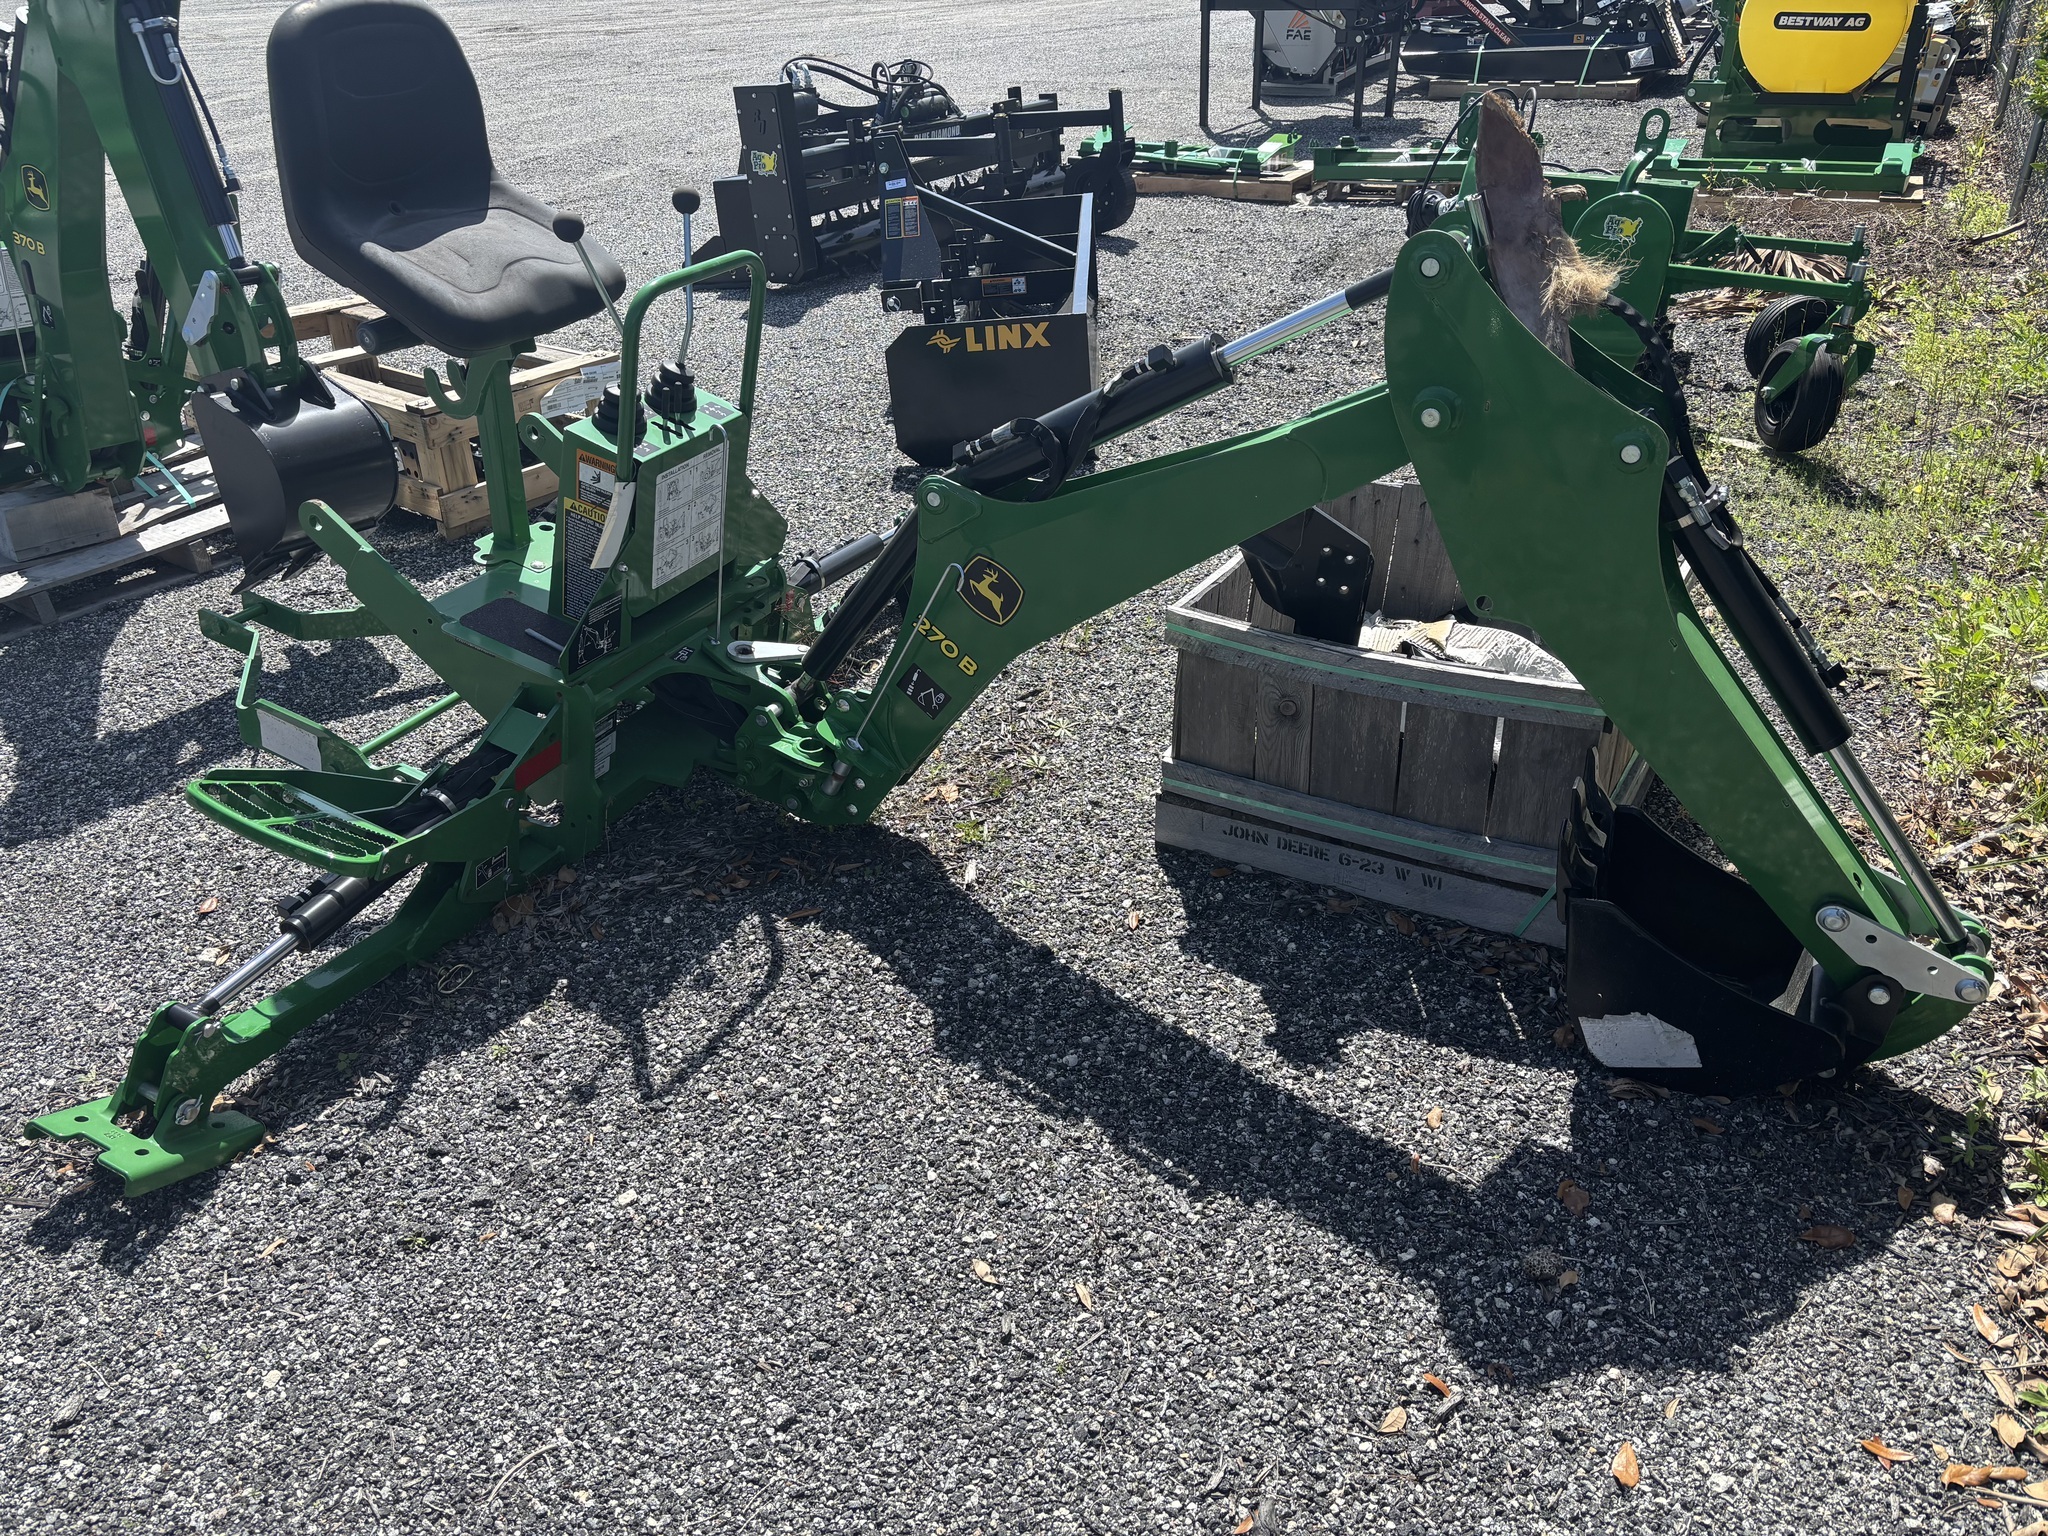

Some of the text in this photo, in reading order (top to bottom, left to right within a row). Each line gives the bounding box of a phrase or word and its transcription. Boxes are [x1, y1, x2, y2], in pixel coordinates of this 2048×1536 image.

[1460, 0, 1511, 45] ANGER STAND CLEAR
[1778, 16, 1866, 27] BESTWAY AG
[1286, 29, 1312, 40] FAE
[931, 125, 960, 139] DIAMOND
[12, 231, 46, 255] 370 B
[965, 321, 1051, 352] LINX
[702, 446, 721, 459] REMOVAL
[589, 454, 616, 473] WARNING
[661, 463, 690, 480] INSTALLATION
[577, 504, 607, 523] CAUTIO
[912, 614, 978, 676] 270 B
[1222, 824, 1269, 846] JOHN
[1276, 836, 1331, 862] DEERE
[1338, 852, 1385, 875] 6-23
[1395, 866, 1412, 882] W
